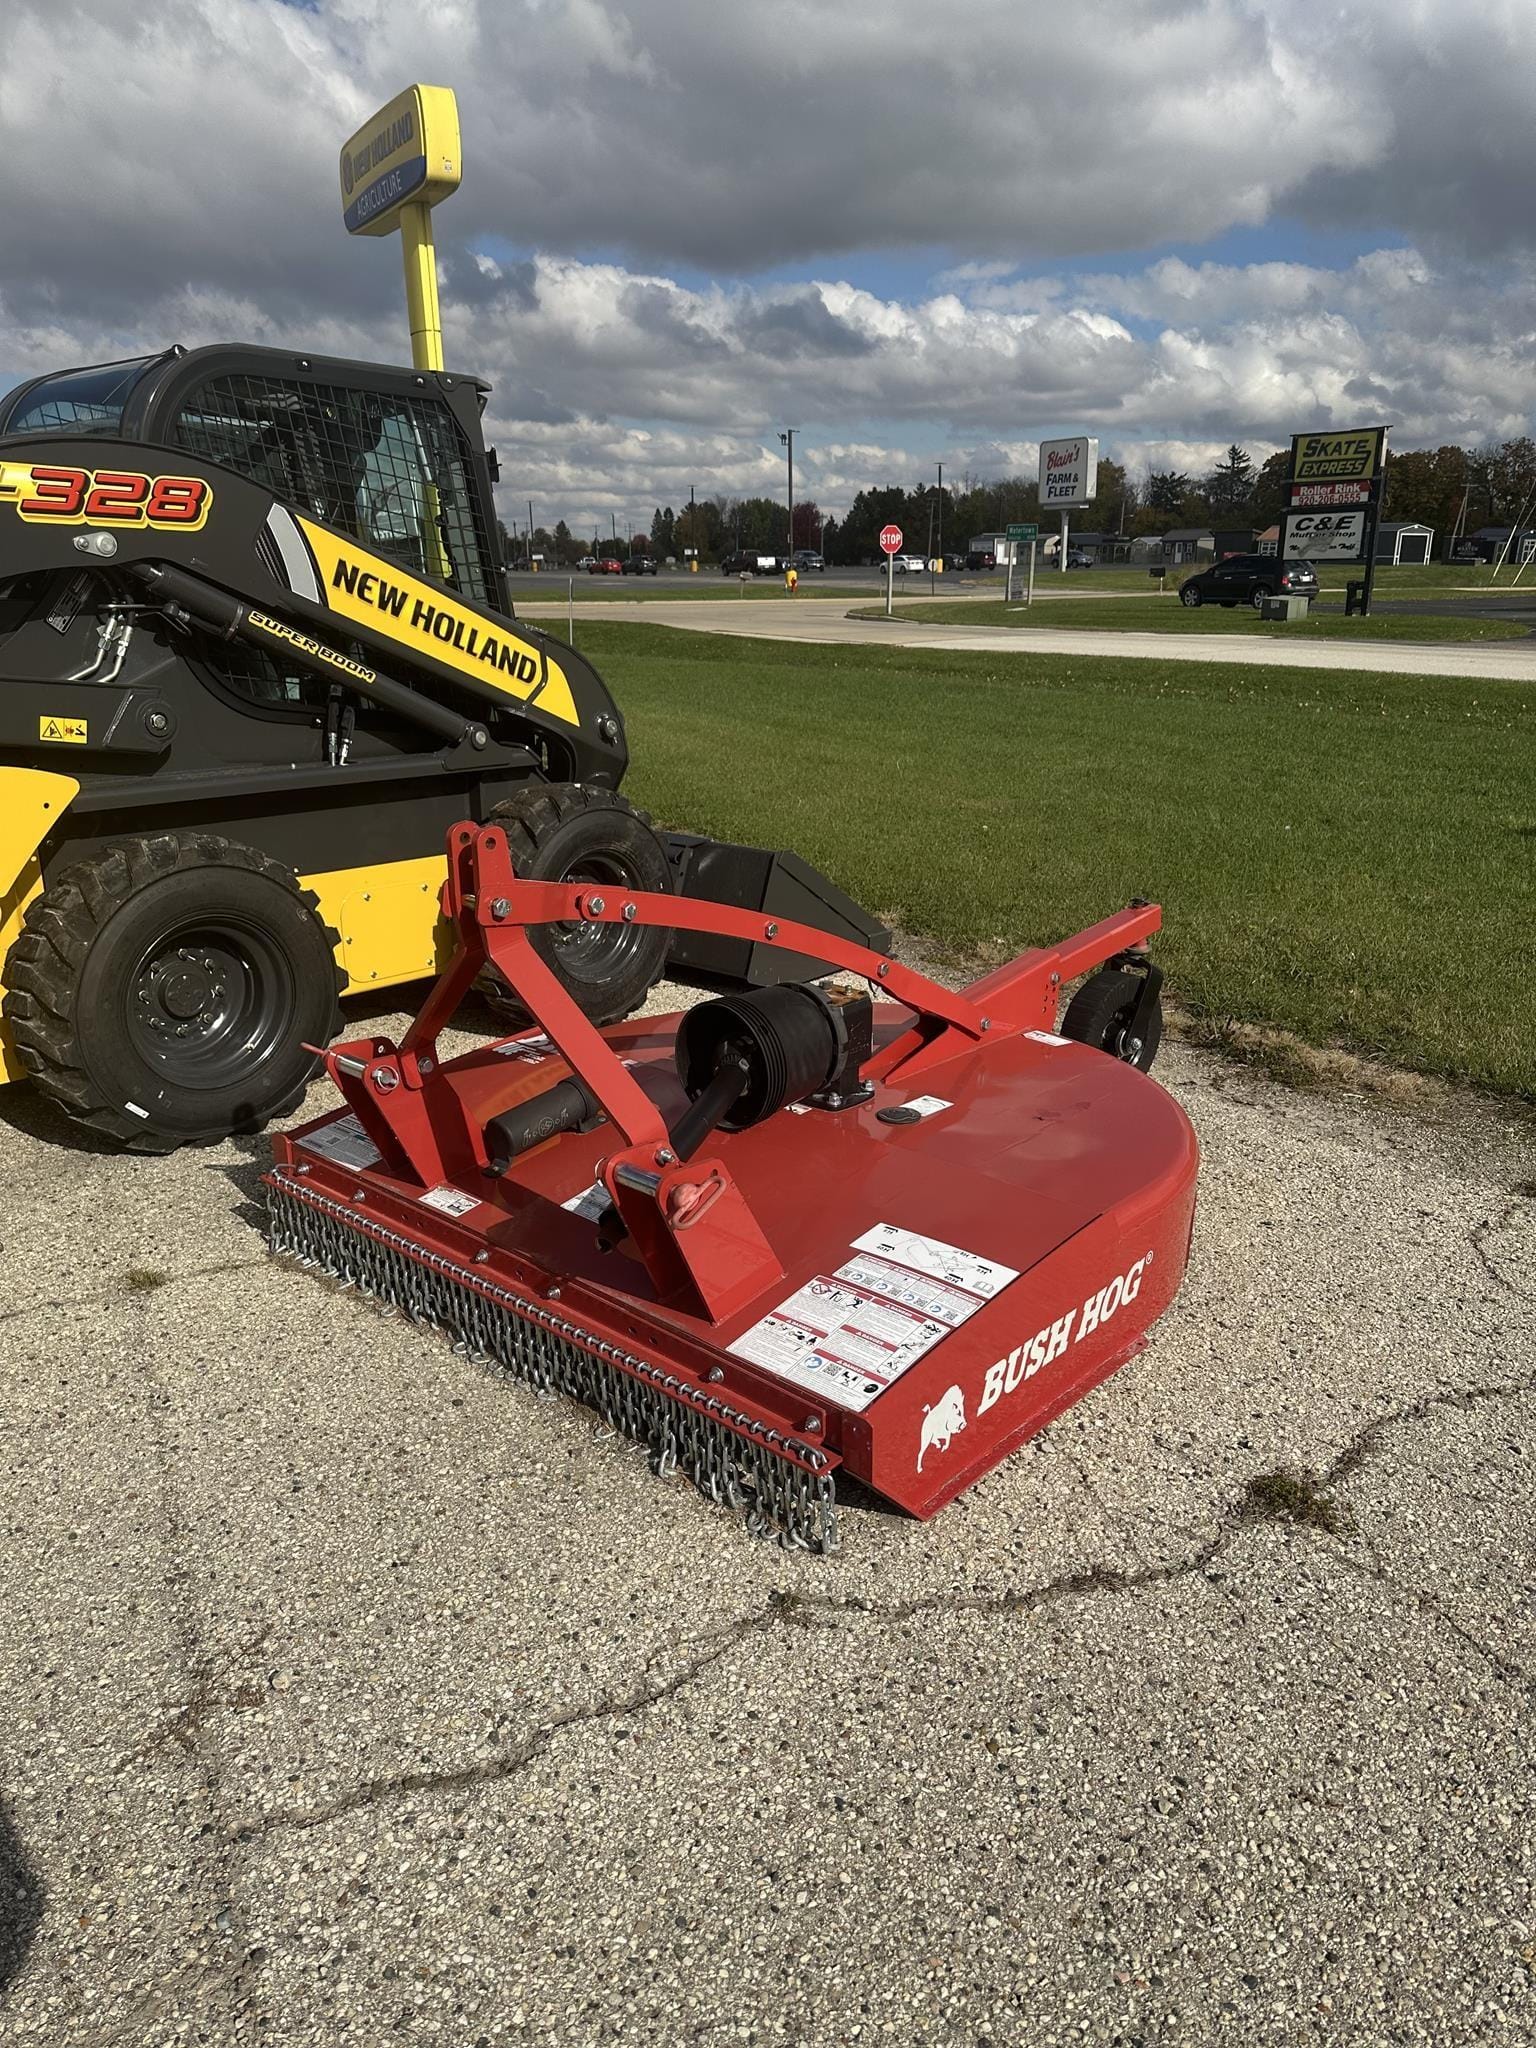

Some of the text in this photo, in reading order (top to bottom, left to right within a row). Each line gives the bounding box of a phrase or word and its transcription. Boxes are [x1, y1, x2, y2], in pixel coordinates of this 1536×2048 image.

[356, 170, 402, 220] AGRICULTURE
[1046, 444, 1080, 470] Blain's
[1303, 439, 1371, 458] SKATE
[1301, 461, 1364, 476] EXPRESS
[1046, 473, 1079, 486] FARM &
[1047, 486, 1077, 498] FLEET
[1300, 483, 1360, 496] Roller Rink
[1294, 516, 1357, 531] C&E
[881, 533, 901, 545] STOP
[332, 559, 537, 685] NEW HOLLAND
[249, 610, 376, 684] SUPER BOOM
[977, 1308, 1077, 1417] BUSH
